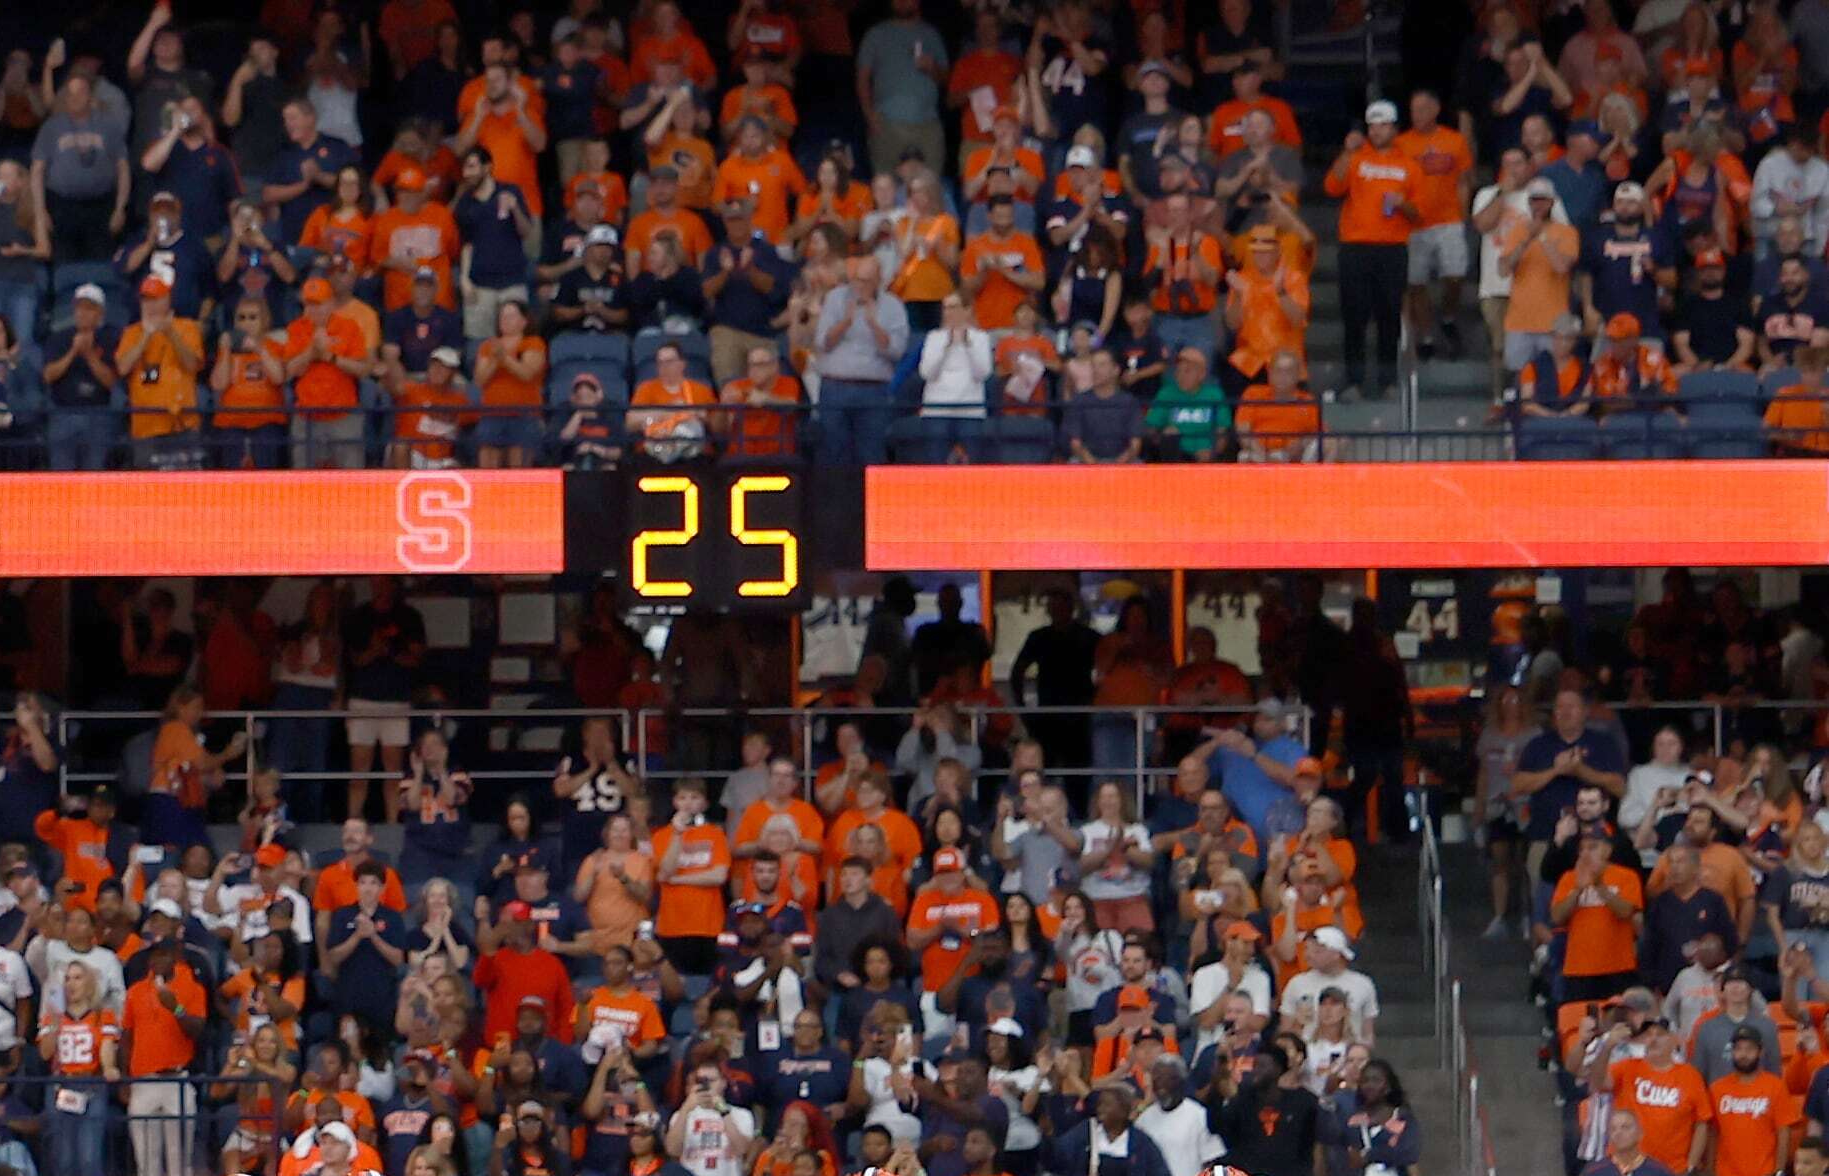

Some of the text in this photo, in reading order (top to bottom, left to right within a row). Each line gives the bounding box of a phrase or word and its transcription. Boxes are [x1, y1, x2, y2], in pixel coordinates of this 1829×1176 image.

[397, 471, 471, 573] S
[630, 475, 799, 598] 25
[1406, 598, 1459, 644] 44
